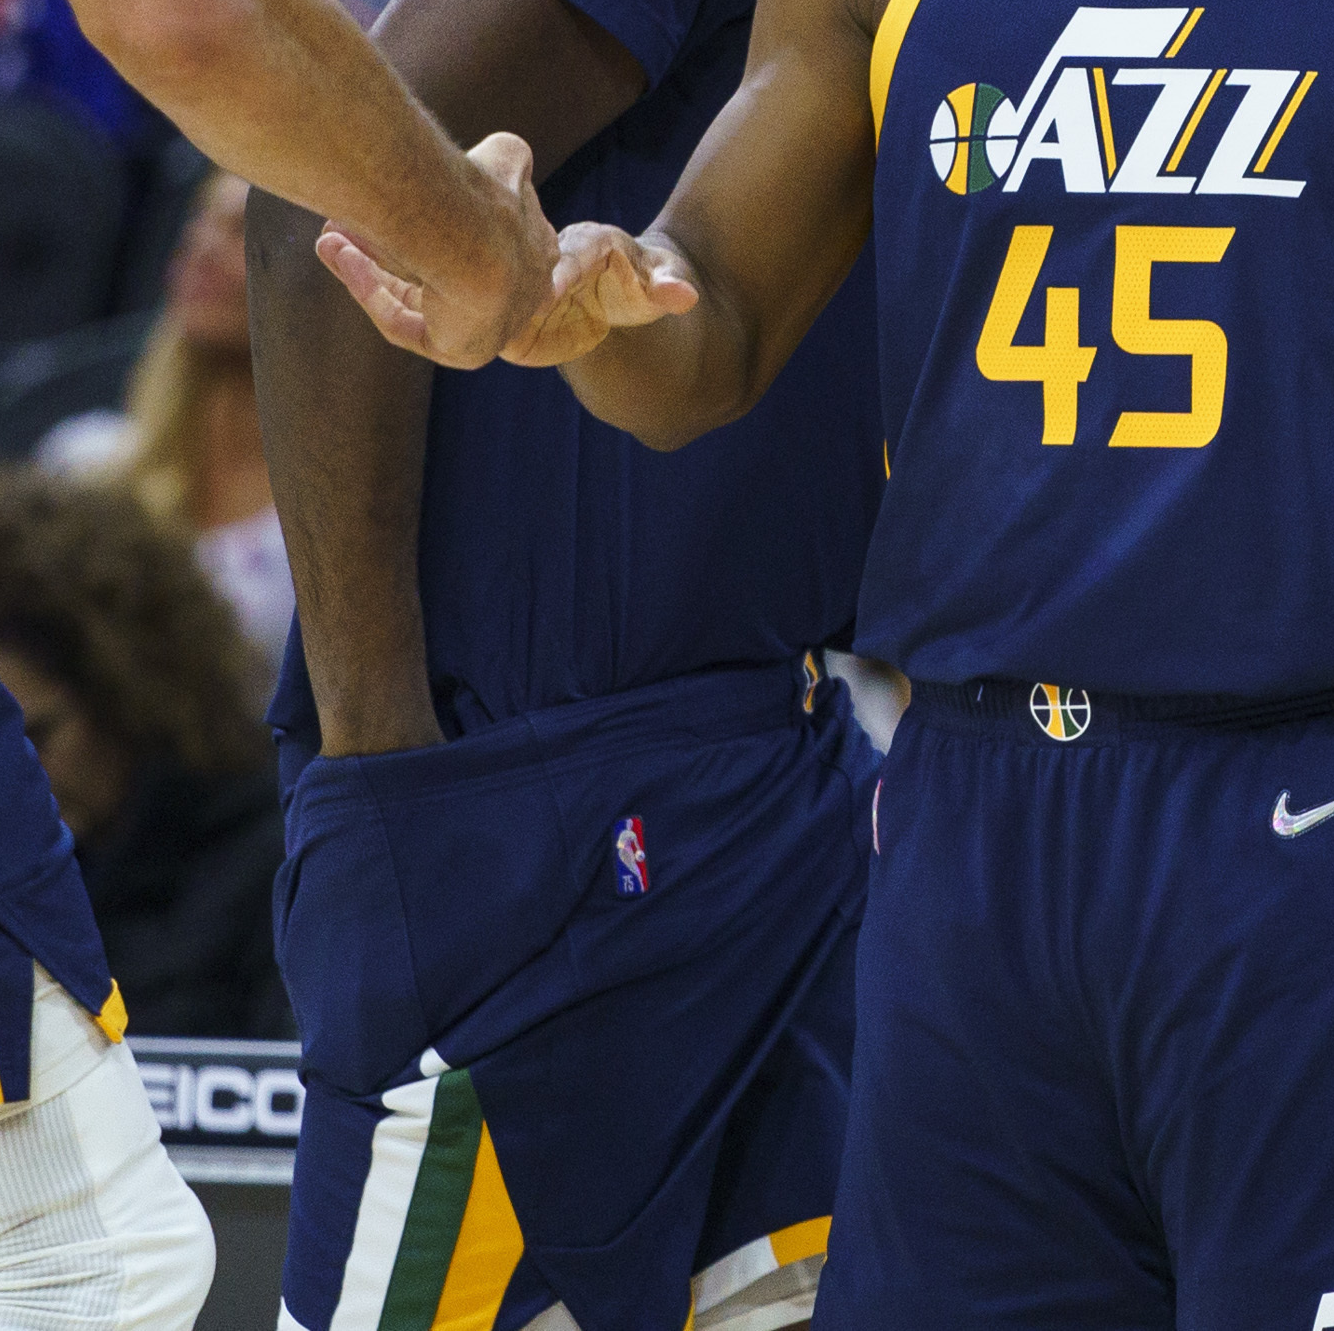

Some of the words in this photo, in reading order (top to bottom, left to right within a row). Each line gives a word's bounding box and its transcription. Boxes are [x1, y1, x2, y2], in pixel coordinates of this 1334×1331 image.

[929, 7, 1319, 198] JAZZ
[975, 225, 1236, 448] 45
[141, 1062, 305, 1137] EICO
